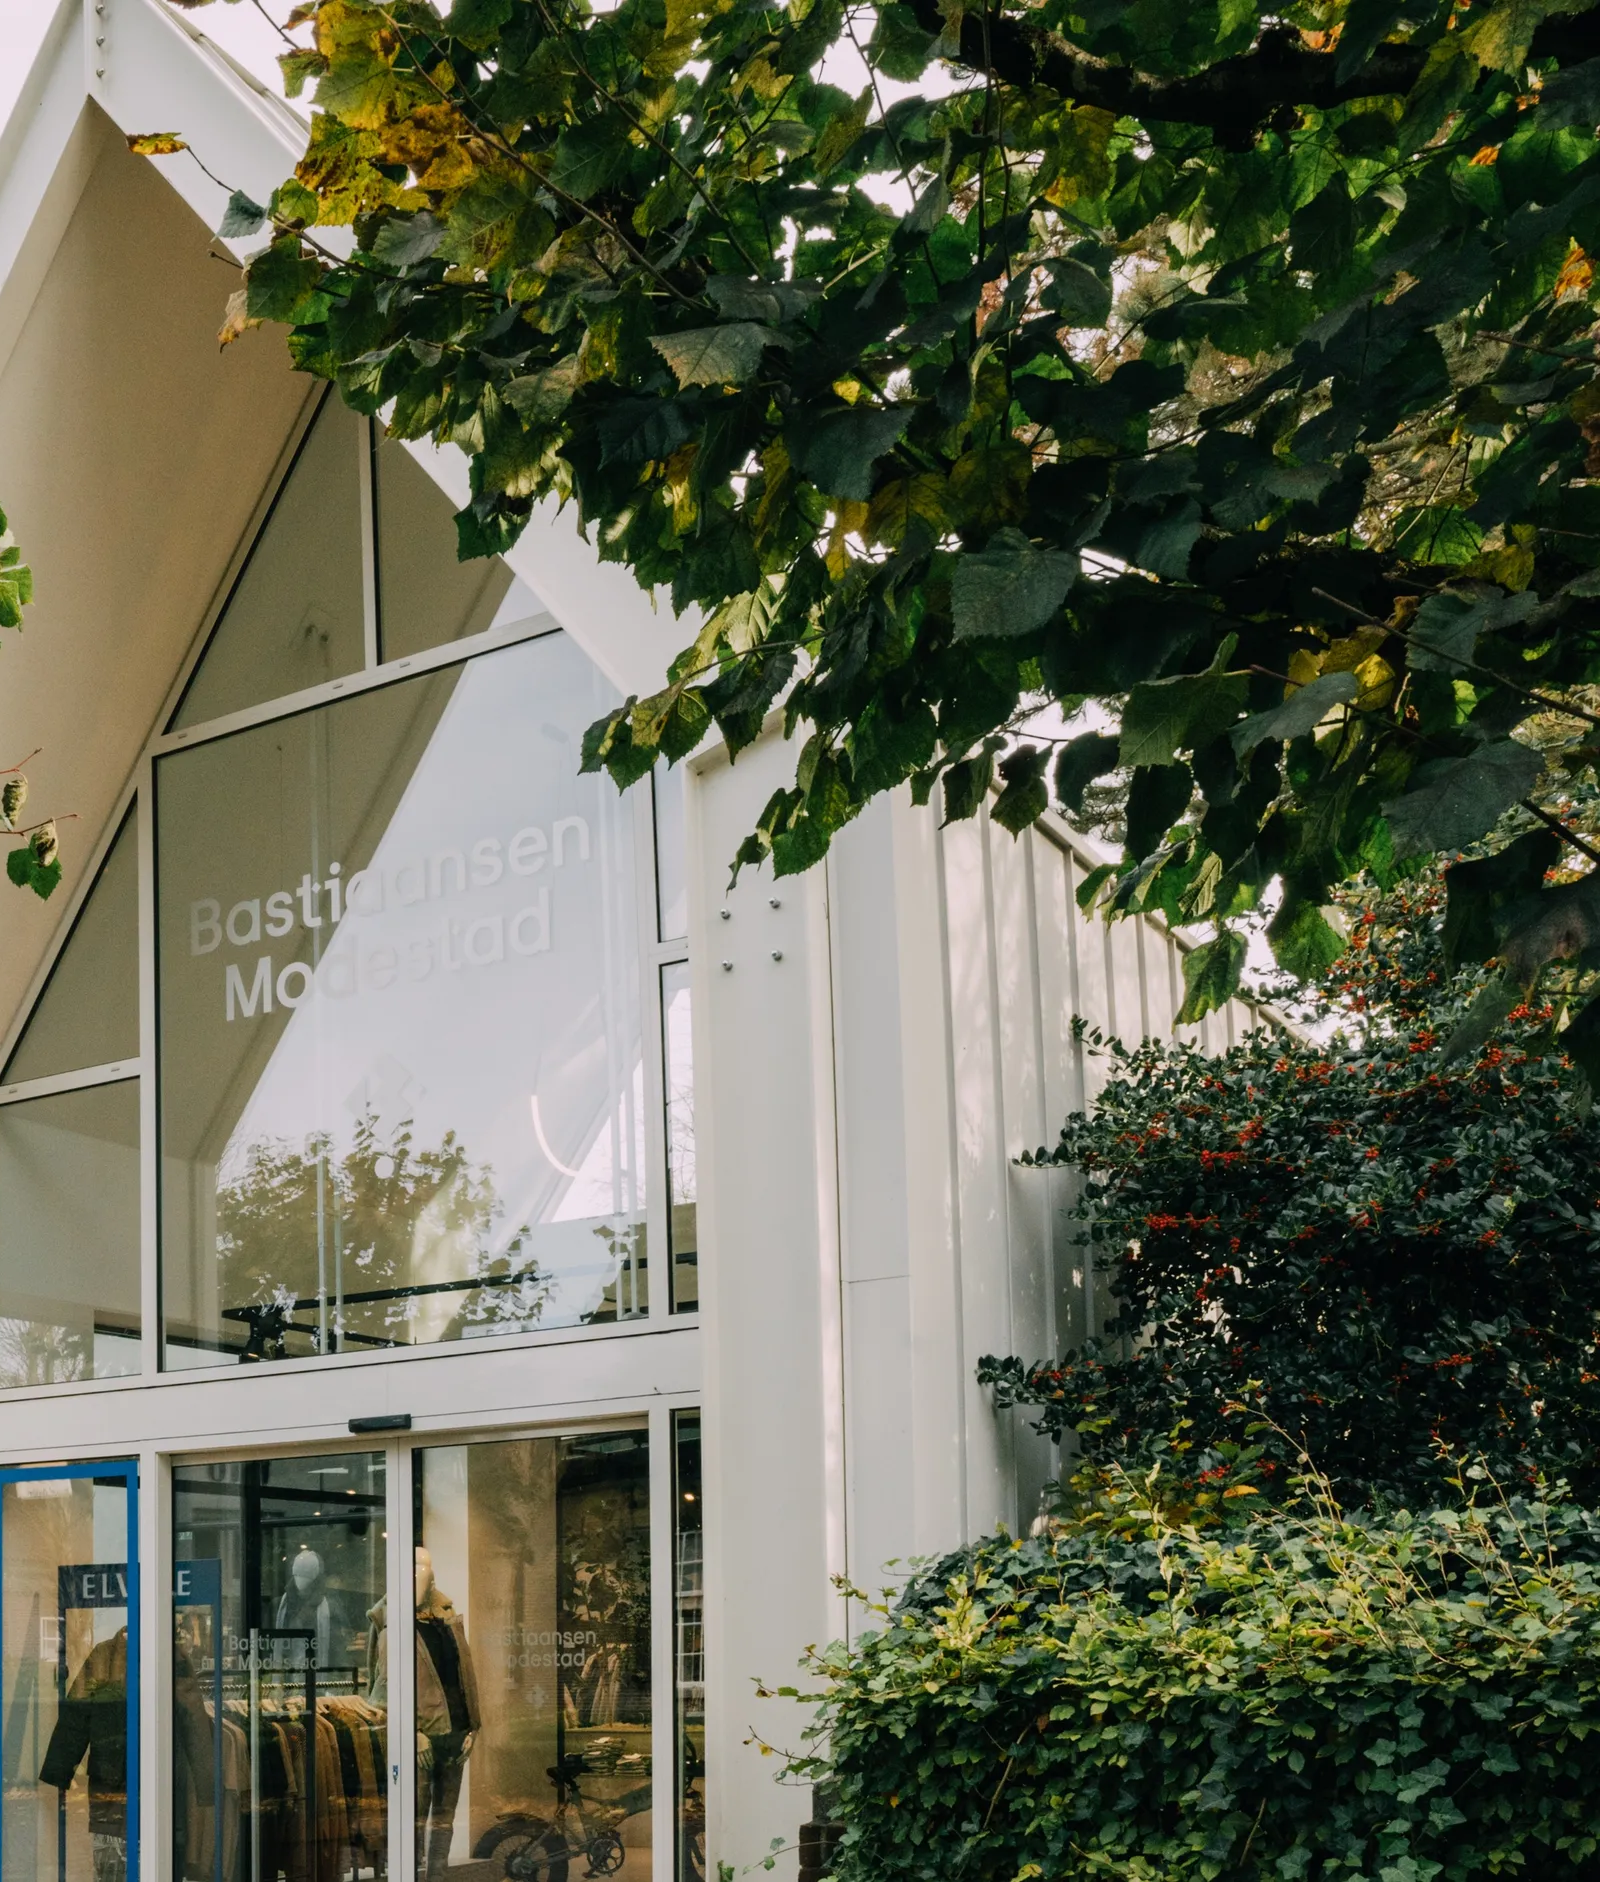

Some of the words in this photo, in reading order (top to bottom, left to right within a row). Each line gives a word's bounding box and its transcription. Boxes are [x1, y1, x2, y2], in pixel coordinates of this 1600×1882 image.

[190, 817, 590, 956] Bastiaansen
[225, 887, 552, 1021] Modestad
[485, 1629, 596, 1646] astiaansen
[238, 1653, 321, 1670] Modesad
[500, 1648, 585, 1667] odestad
